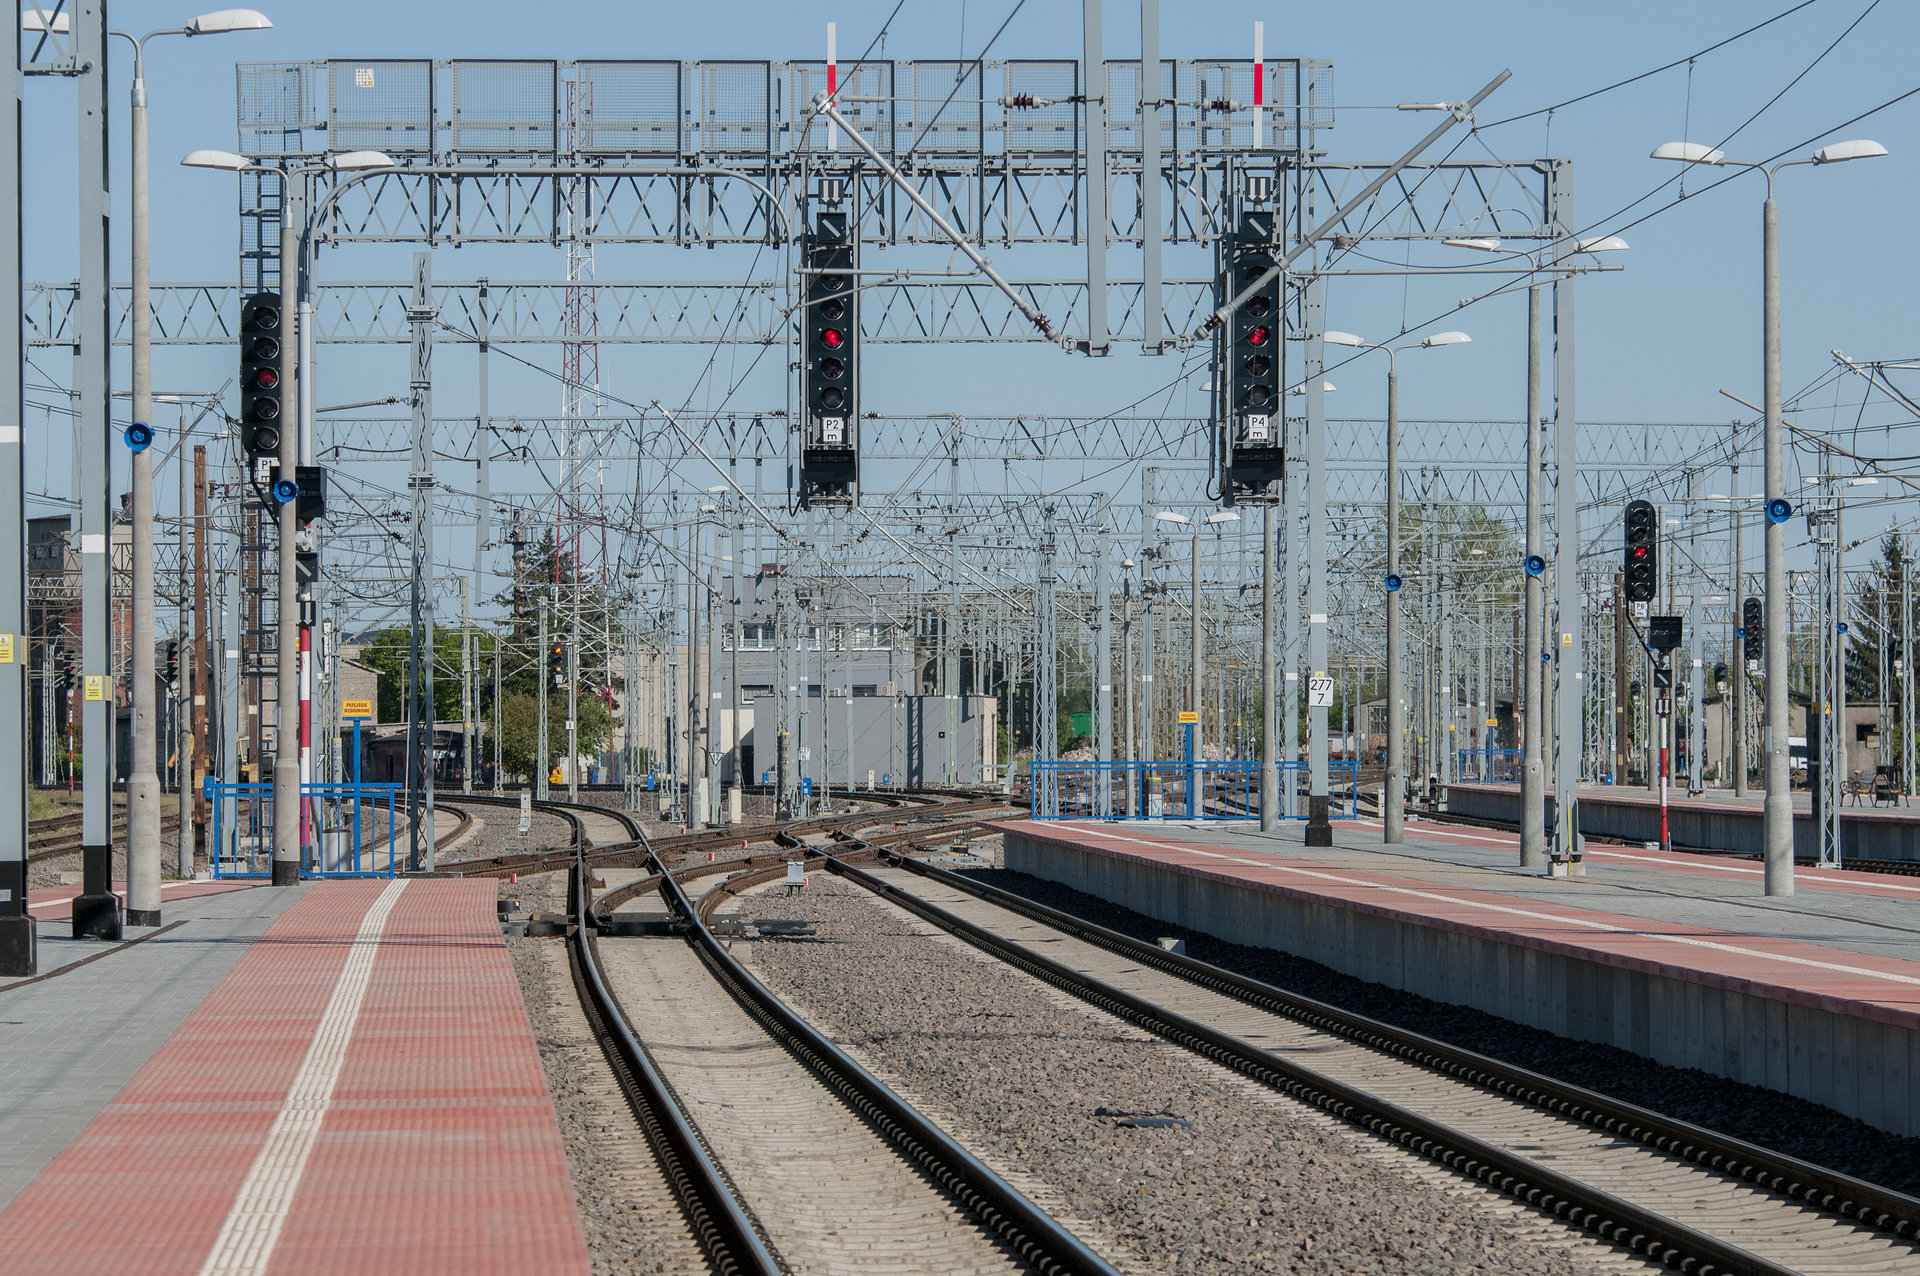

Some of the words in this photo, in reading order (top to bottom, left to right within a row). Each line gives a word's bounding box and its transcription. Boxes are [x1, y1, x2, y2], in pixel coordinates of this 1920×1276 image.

[826, 420, 838, 429] P2
[1252, 417, 1264, 426] P4
[1310, 679, 1332, 690] 277
[1317, 694, 1325, 704] 7
